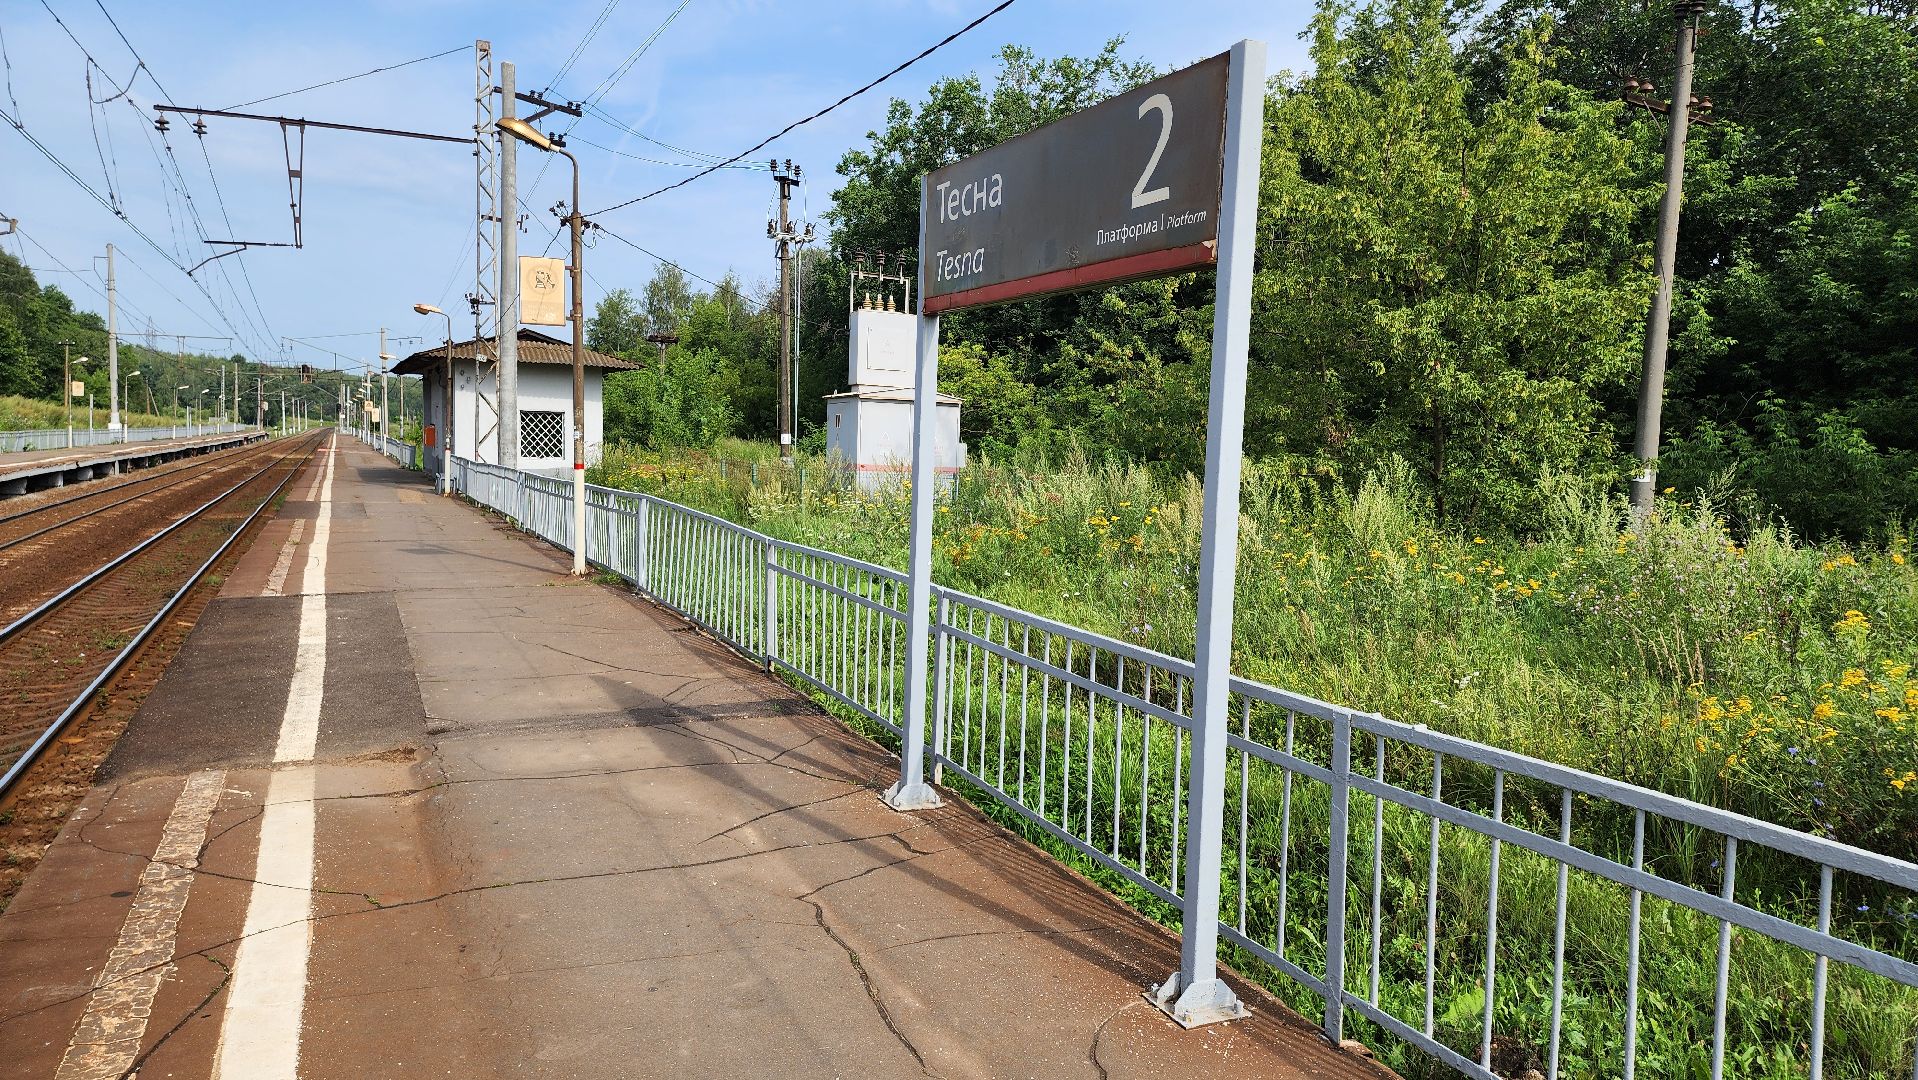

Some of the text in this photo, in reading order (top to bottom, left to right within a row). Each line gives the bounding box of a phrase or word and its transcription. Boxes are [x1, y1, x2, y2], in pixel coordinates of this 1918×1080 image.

[1131, 93, 1174, 209] 2
[936, 173, 1003, 224] Тесна
[1096, 210, 1207, 246] Платформа Platform
[936, 247, 985, 282] Tesna
